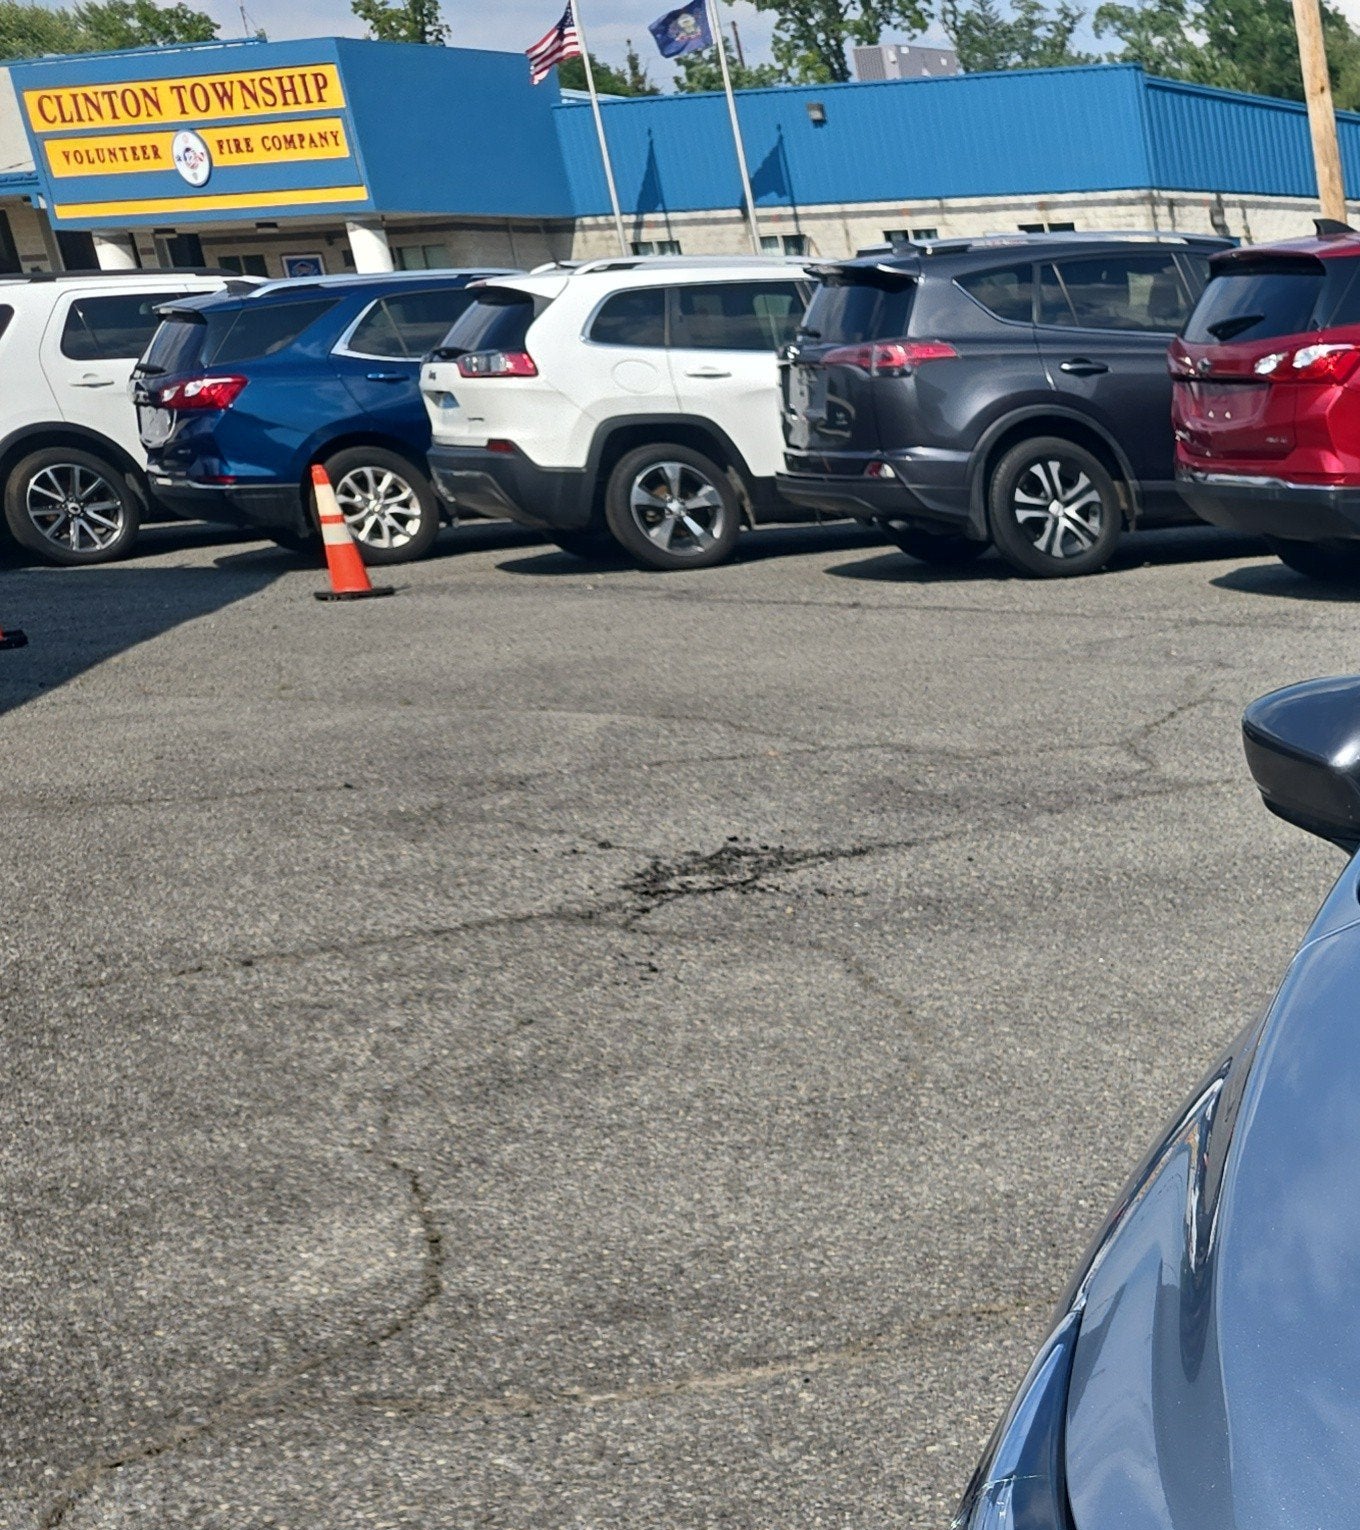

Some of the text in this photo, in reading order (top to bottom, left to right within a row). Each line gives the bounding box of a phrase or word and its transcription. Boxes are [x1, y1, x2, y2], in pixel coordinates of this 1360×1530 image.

[37, 72, 328, 124] CLINTON TOWNSHIP
[62, 130, 340, 166] VOLUNTEER FIRE COMPANY
